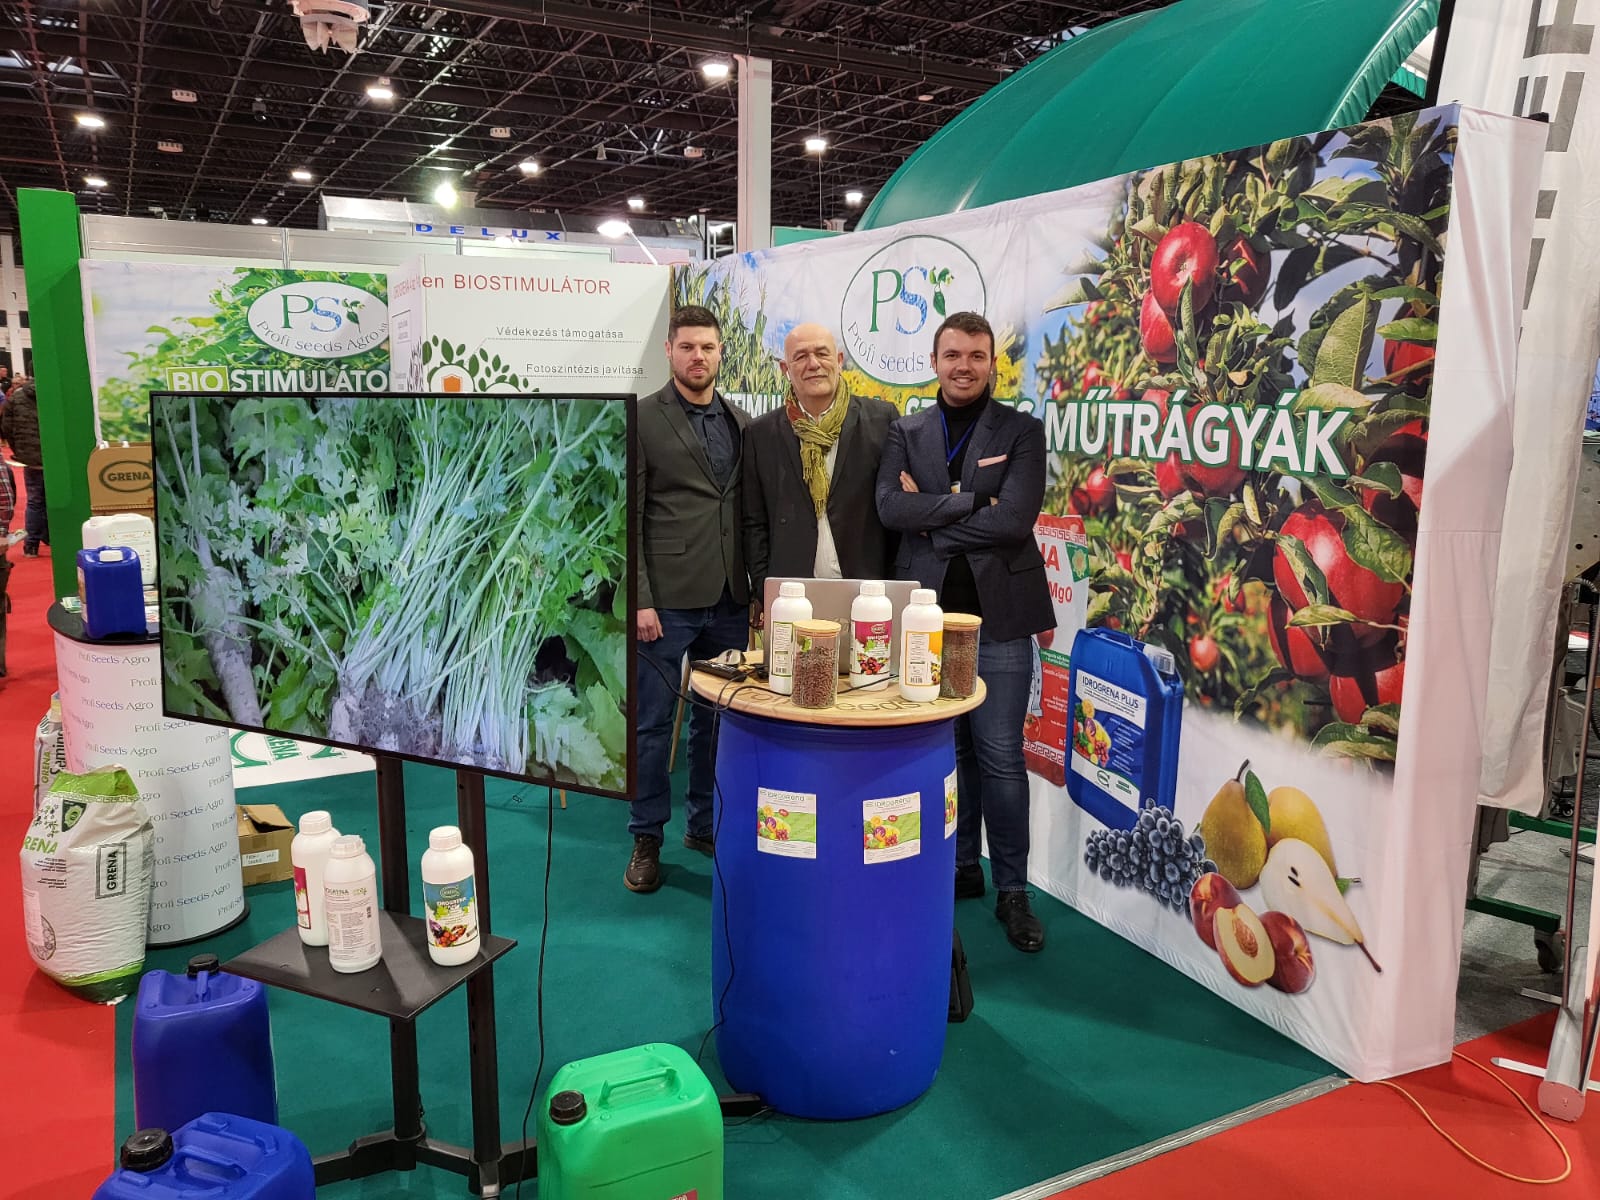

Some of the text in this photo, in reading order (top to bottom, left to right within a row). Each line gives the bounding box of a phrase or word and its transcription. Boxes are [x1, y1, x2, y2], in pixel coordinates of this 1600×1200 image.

[415, 223, 561, 241] DELUX
[454, 273, 612, 296] BIOSTIMULÁTOR
[869, 265, 928, 335] PS
[281, 294, 342, 332] PS
[256, 320, 291, 347] Profi
[294, 341, 343, 353] seeds
[347, 331, 379, 350] Agro
[496, 326, 624, 339] Védekezés támogatása
[848, 321, 924, 372] Profi seeds
[526, 363, 644, 376] Fotoszintézis javítása
[173, 370, 223, 391] BIO
[1048, 388, 1350, 476] MŰTRÁGYÁK
[107, 472, 152, 482] GRENA
[91, 655, 120, 665] Seeds
[122, 656, 151, 667] Agro
[131, 678, 158, 687] Profi
[1082, 675, 1121, 701] IDROGRENA
[1121, 693, 1139, 708] PLUS
[95, 700, 124, 710] Seeds
[126, 701, 154, 712] Agro
[135, 723, 161, 733] Profi
[99, 746, 128, 755] Seeds
[130, 747, 157, 758] Agro
[41, 752, 51, 784] GRENA
[138, 768, 165, 778] Profi
[166, 762, 200, 775] Seeds
[170, 806, 204, 819] Seeds
[173, 850, 207, 864] Seeds
[208, 841, 228, 854] Agro
[106, 849, 118, 891] GRENA
[176, 893, 210, 907] Seeds
[211, 882, 231, 897] Agro
